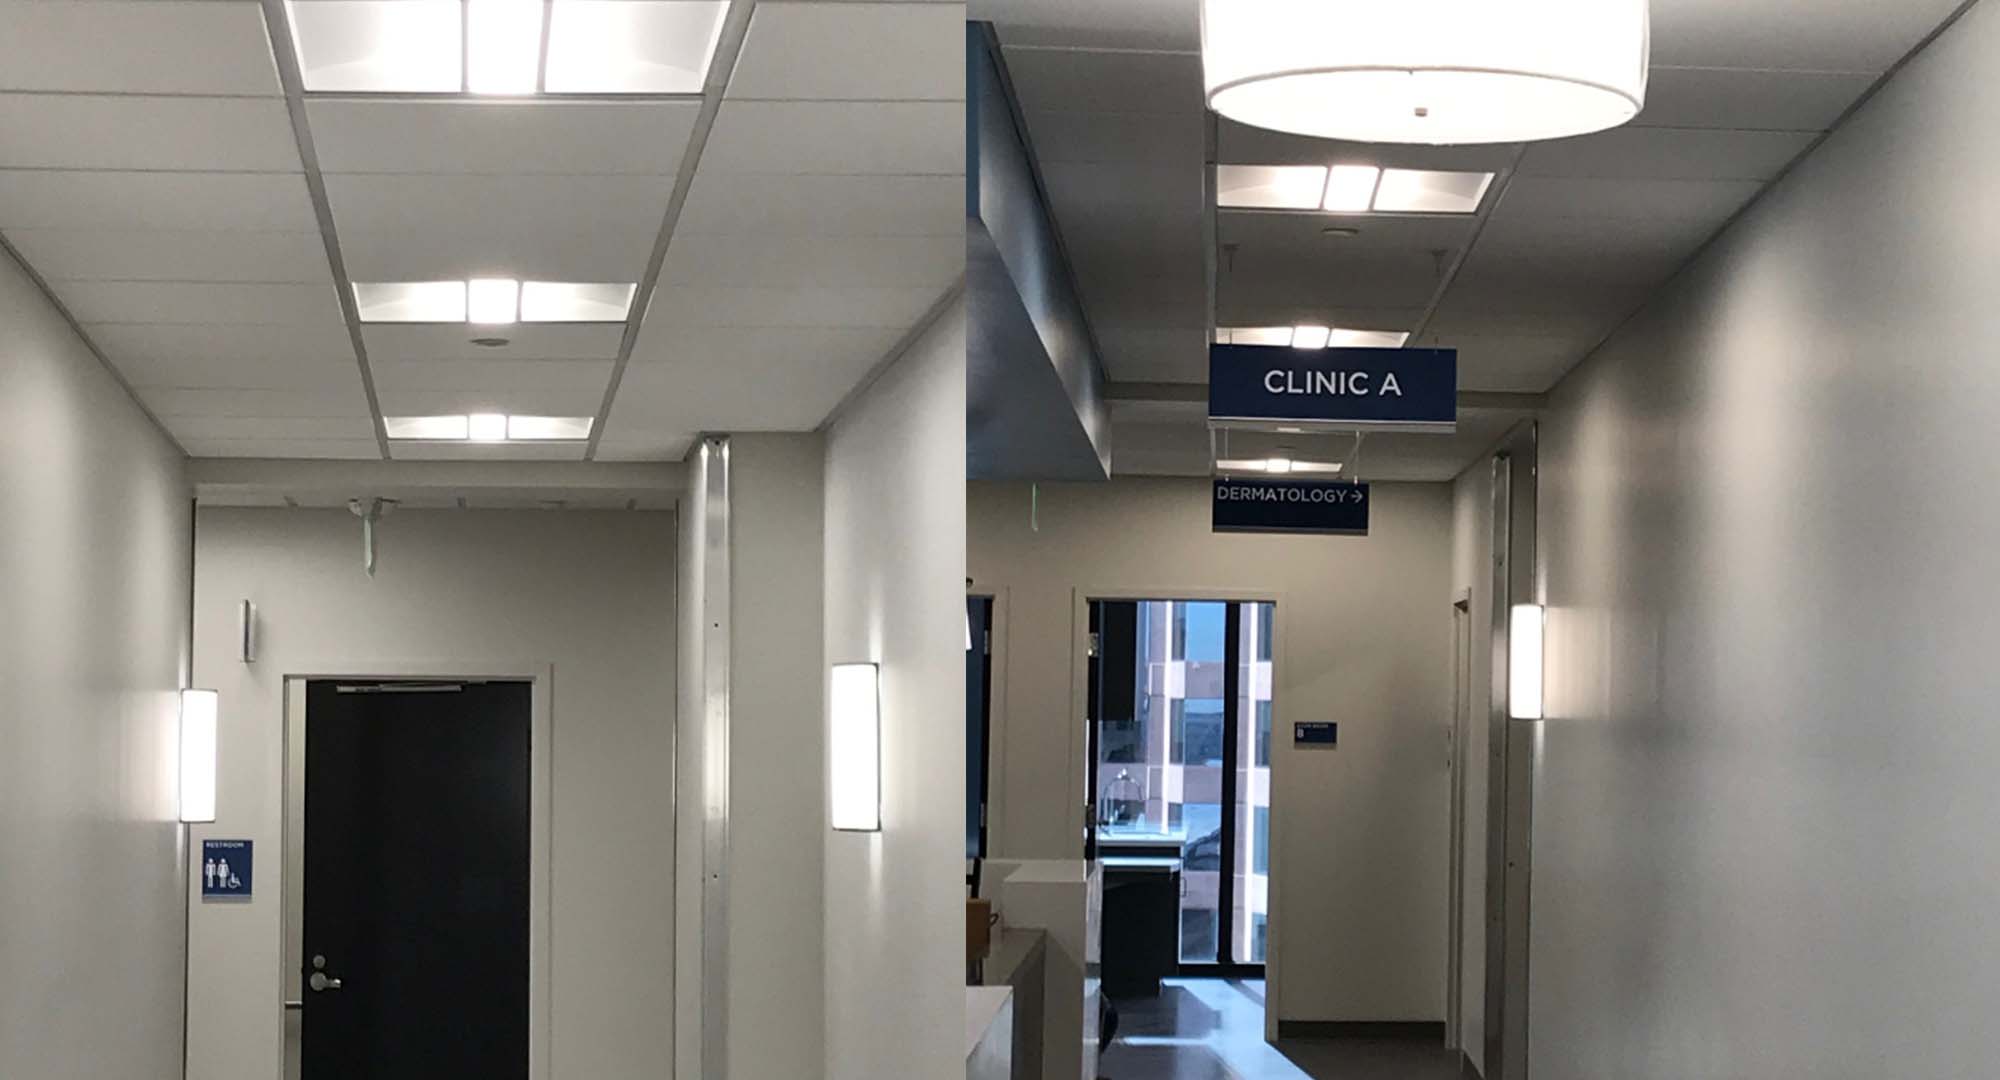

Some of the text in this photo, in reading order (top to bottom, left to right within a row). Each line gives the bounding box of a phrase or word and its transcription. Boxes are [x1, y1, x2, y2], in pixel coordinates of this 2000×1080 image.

[1264, 370, 1402, 396] CLINIC A
[1217, 486, 1347, 503] DERMATOLOGY
